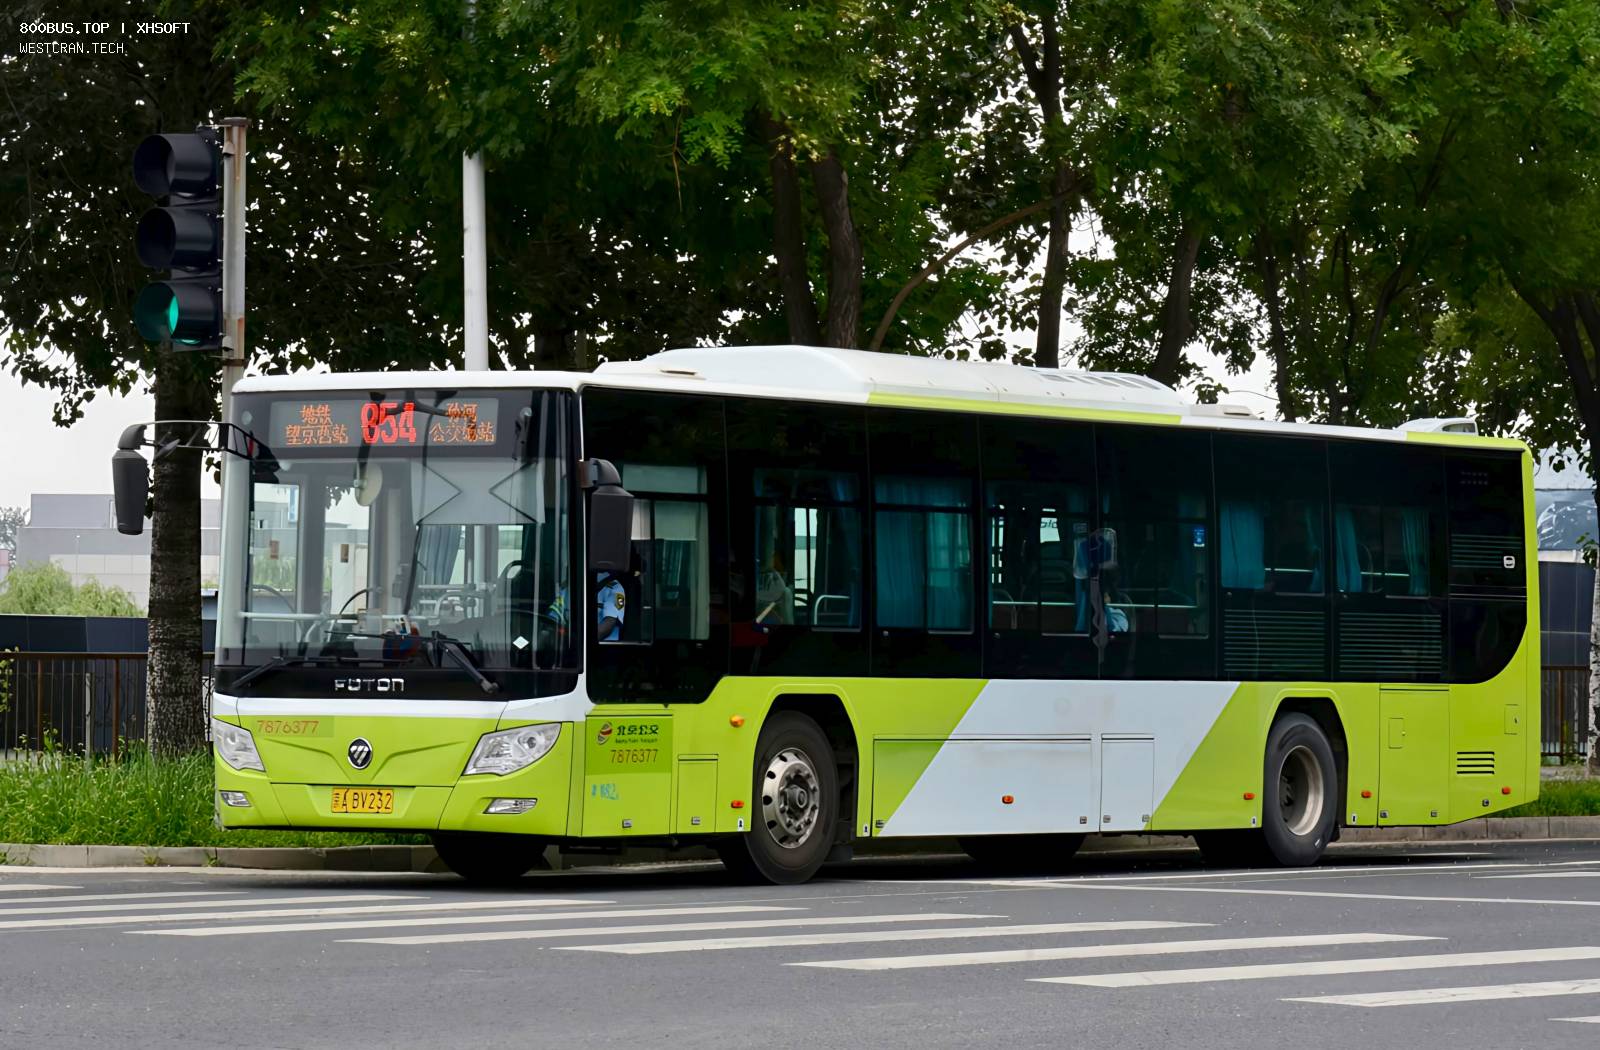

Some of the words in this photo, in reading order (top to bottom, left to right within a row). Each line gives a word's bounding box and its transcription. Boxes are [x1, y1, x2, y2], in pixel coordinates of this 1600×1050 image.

[360, 402, 417, 444] 854
[285, 424, 349, 445] 望京西站
[334, 678, 405, 692] FOTON
[256, 720, 320, 735] 7876377
[611, 748, 659, 763] 7876377
